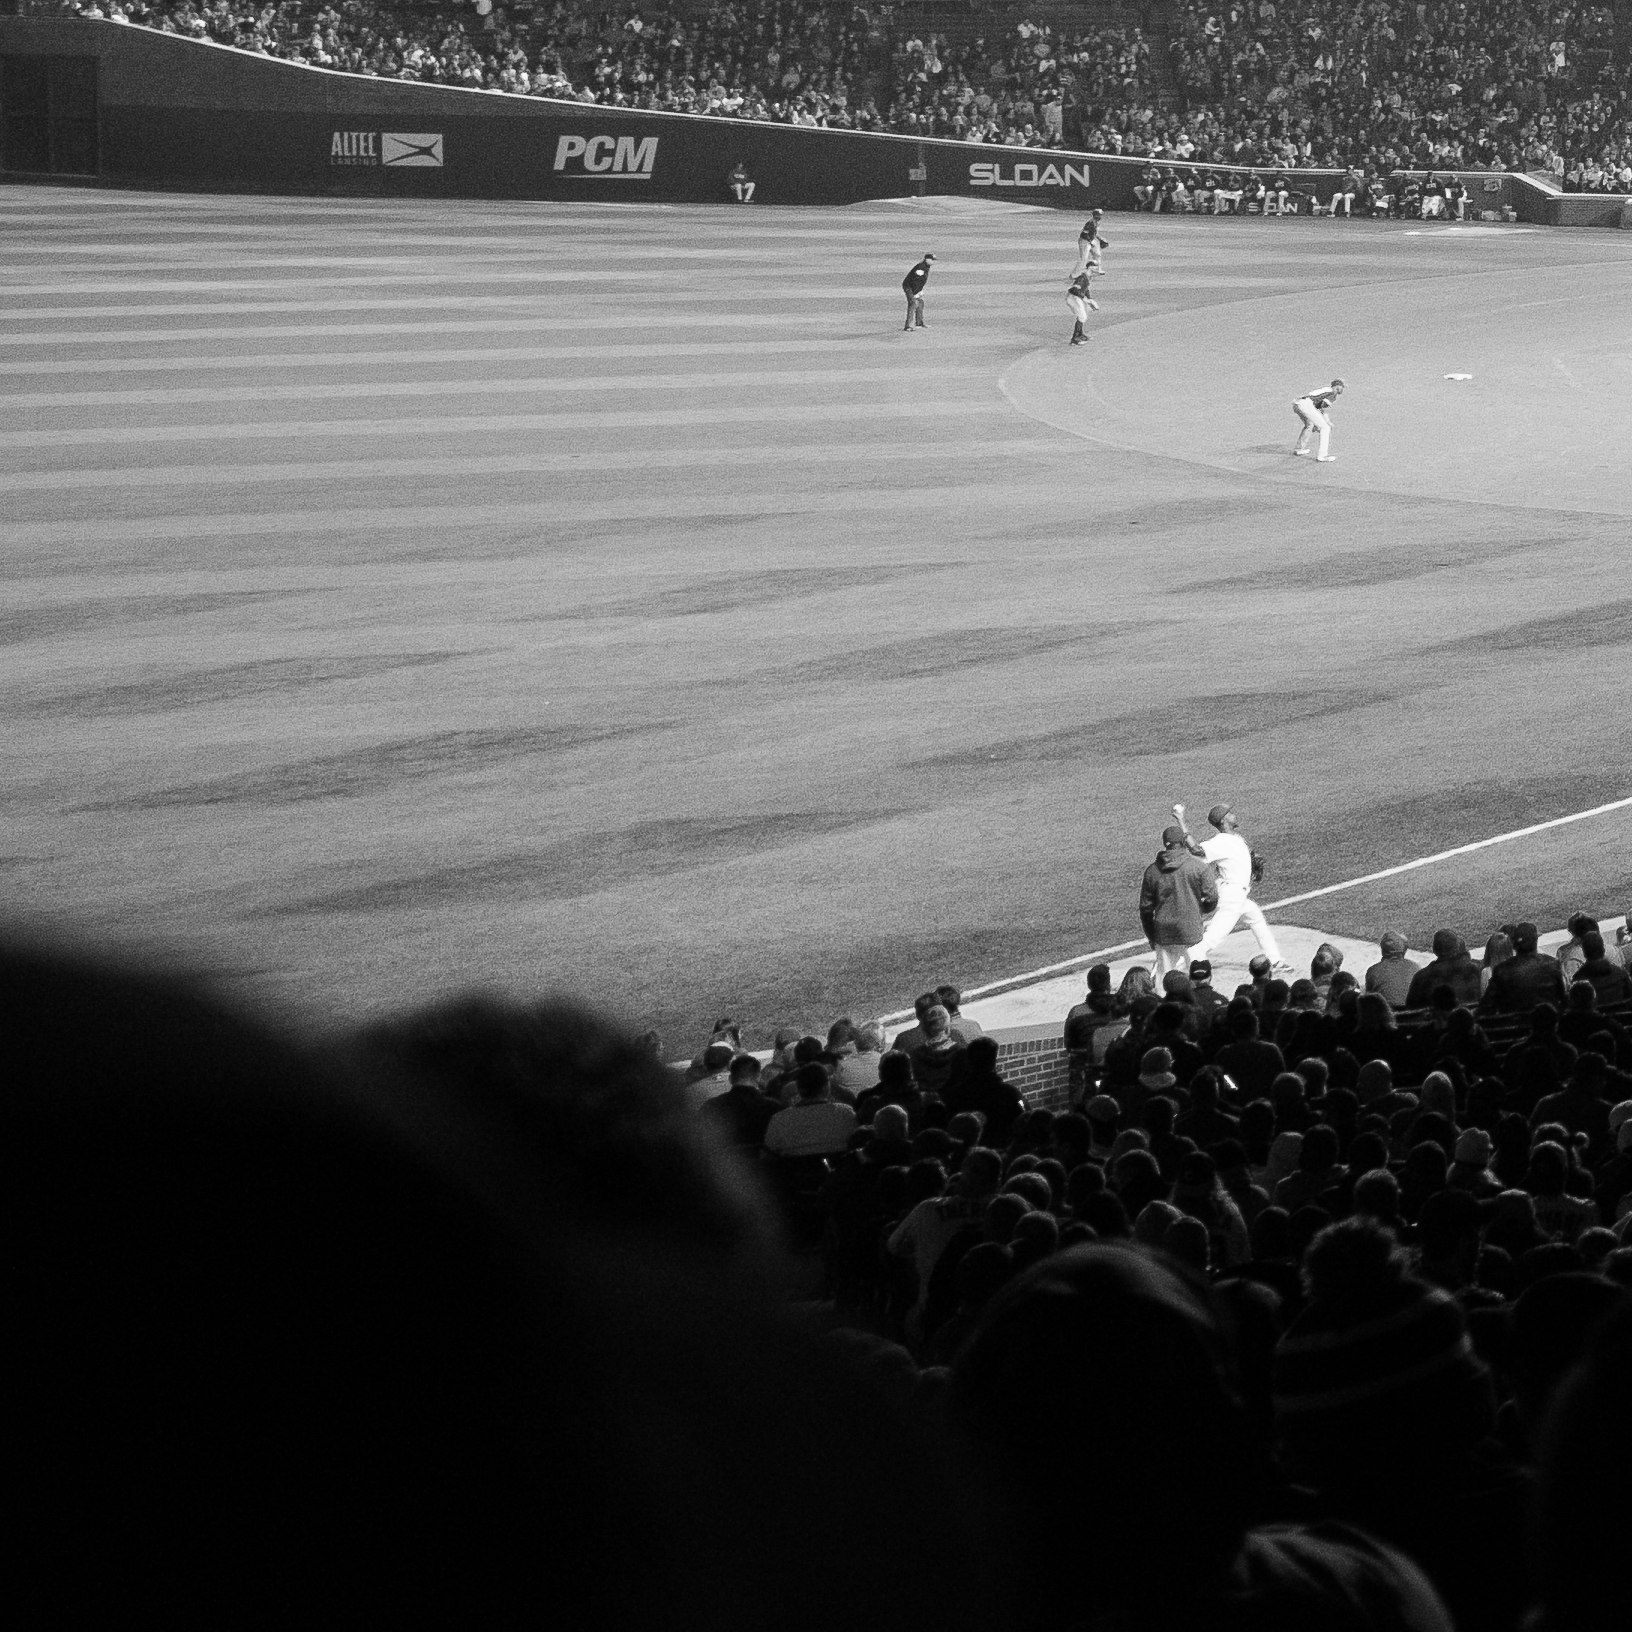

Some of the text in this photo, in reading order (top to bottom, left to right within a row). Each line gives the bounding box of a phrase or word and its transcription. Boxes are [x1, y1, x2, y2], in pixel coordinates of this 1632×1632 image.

[331, 132, 377, 157] ALTEC
[553, 135, 659, 173] PCM
[969, 163, 1090, 187] SLOAN
